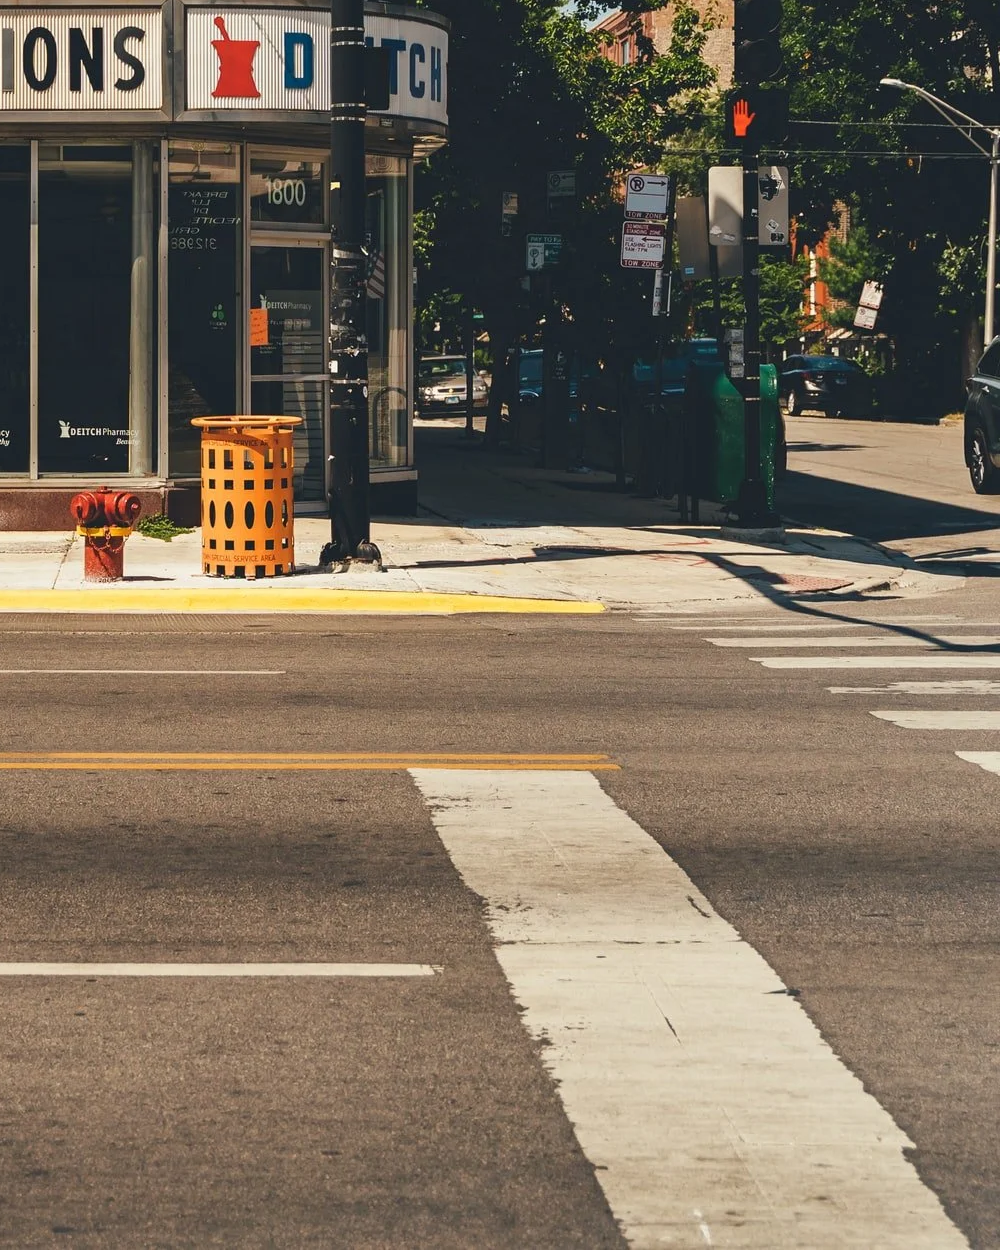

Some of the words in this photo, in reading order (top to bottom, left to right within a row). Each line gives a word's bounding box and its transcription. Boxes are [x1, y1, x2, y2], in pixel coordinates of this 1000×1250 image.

[284, 32, 441, 102] DTCH
[264, 176, 306, 206] 1800
[266, 301, 288, 310] DEITCH
[288, 301, 311, 311] Pharmacy
[70, 427, 102, 436] DEITCH
[102, 427, 140, 438] Pharmacy
[211, 554, 231, 562] SPECIAL
[233, 554, 259, 562] SERVICE
[260, 554, 276, 562] AREA
